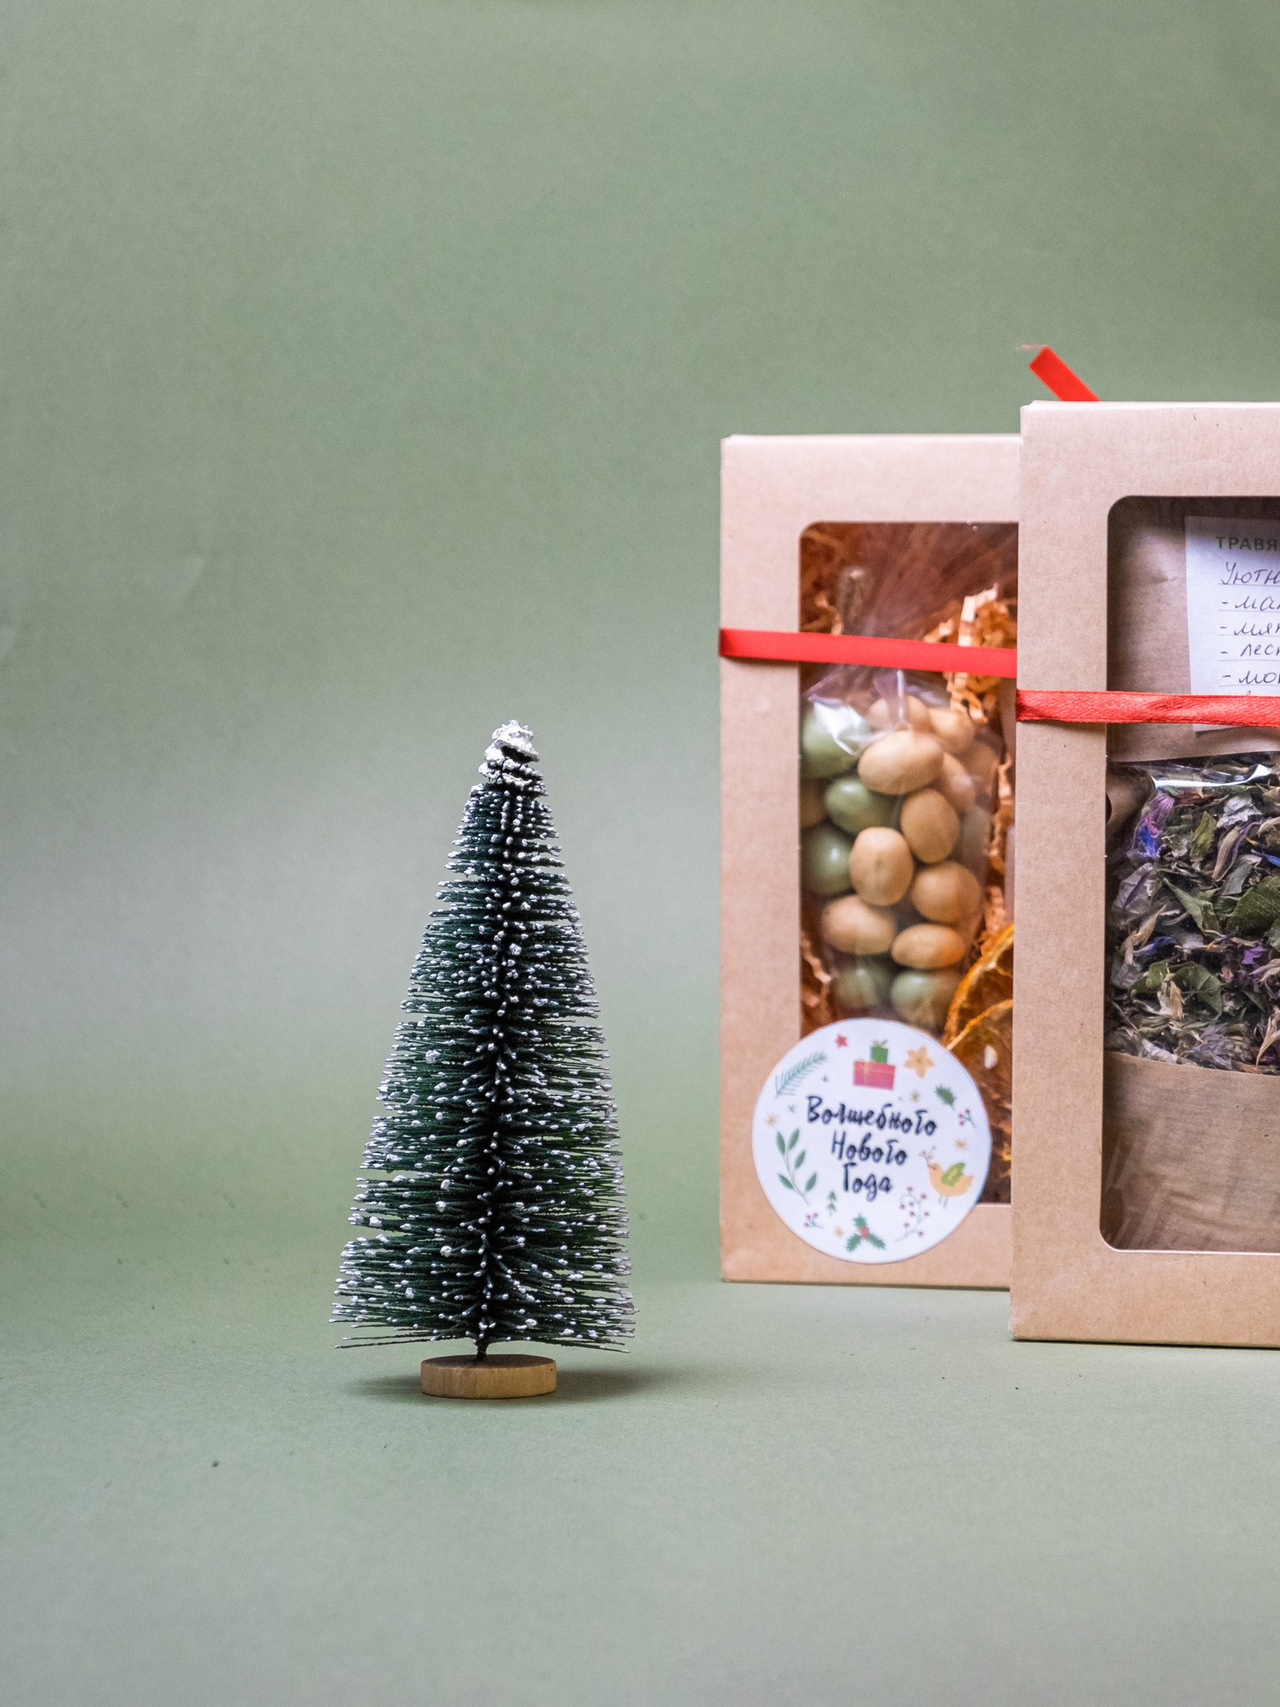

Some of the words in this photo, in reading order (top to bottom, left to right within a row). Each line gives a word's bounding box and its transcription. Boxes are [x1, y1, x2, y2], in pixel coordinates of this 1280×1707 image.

[806, 1095, 938, 1137] Волшебного
[830, 1130, 908, 1166] Нового
[842, 1161, 893, 1203] Года
